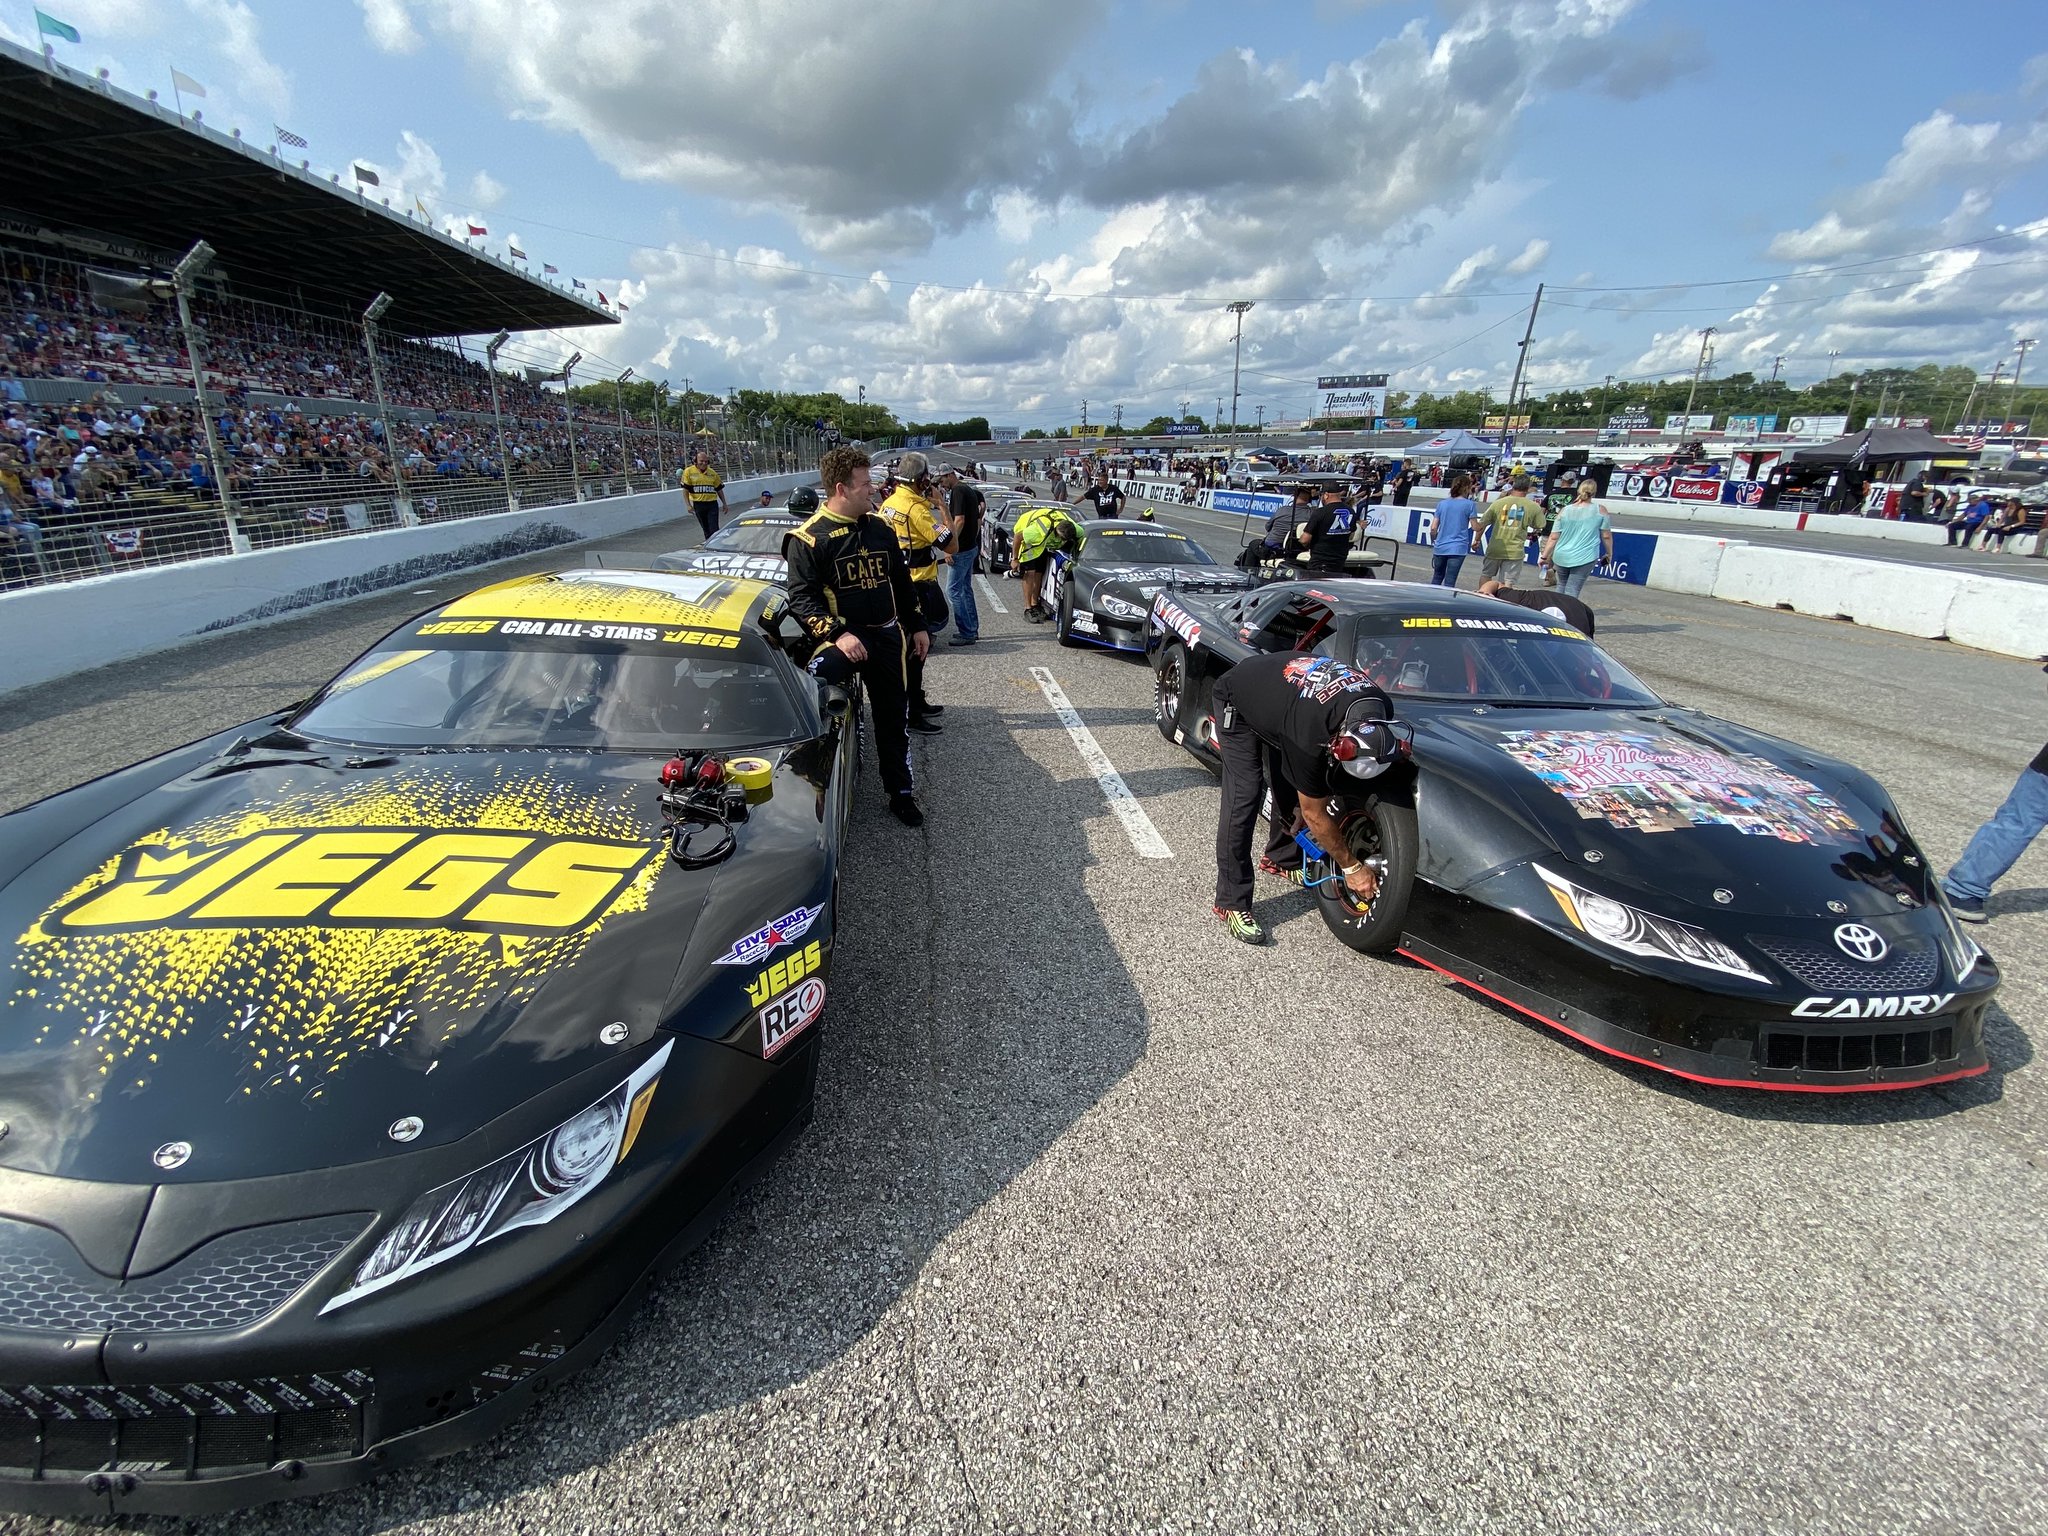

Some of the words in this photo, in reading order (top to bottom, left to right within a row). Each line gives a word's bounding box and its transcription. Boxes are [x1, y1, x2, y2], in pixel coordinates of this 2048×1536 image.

[1325, 391, 1375, 409] Nashville
[1077, 426, 1099, 434] JEGS
[1124, 480, 1146, 498] 400
[1149, 485, 1162, 501] OCT
[1198, 490, 1210, 508] 31
[1230, 497, 1245, 509] WORLD
[1675, 483, 1714, 496] Edelbrock
[846, 557, 885, 581] CAFE
[861, 578, 878, 590] CBD
[416, 620, 500, 635] JEGS
[500, 620, 545, 635] CRA
[549, 622, 658, 641] ALL-STARS
[662, 629, 742, 649] JEGS
[1402, 617, 1453, 628] JEGS
[1455, 618, 1487, 630] CRA
[1486, 620, 1549, 635] ALL-STARS
[1549, 626, 1587, 641] JEGS
[1563, 745, 1604, 769] In
[1600, 743, 1711, 772] Memory
[1557, 761, 1680, 793] Jillian
[62, 829, 655, 928] JEGS
[735, 927, 771, 956] FIVE
[772, 908, 809, 932] STAR
[739, 943, 769, 962] RaceCar
[784, 922, 808, 937] Bodies
[744, 939, 822, 1008] JEGS
[1790, 993, 1956, 1018] CAMRY
[784, 1016, 815, 1044] ELECTRONICS
